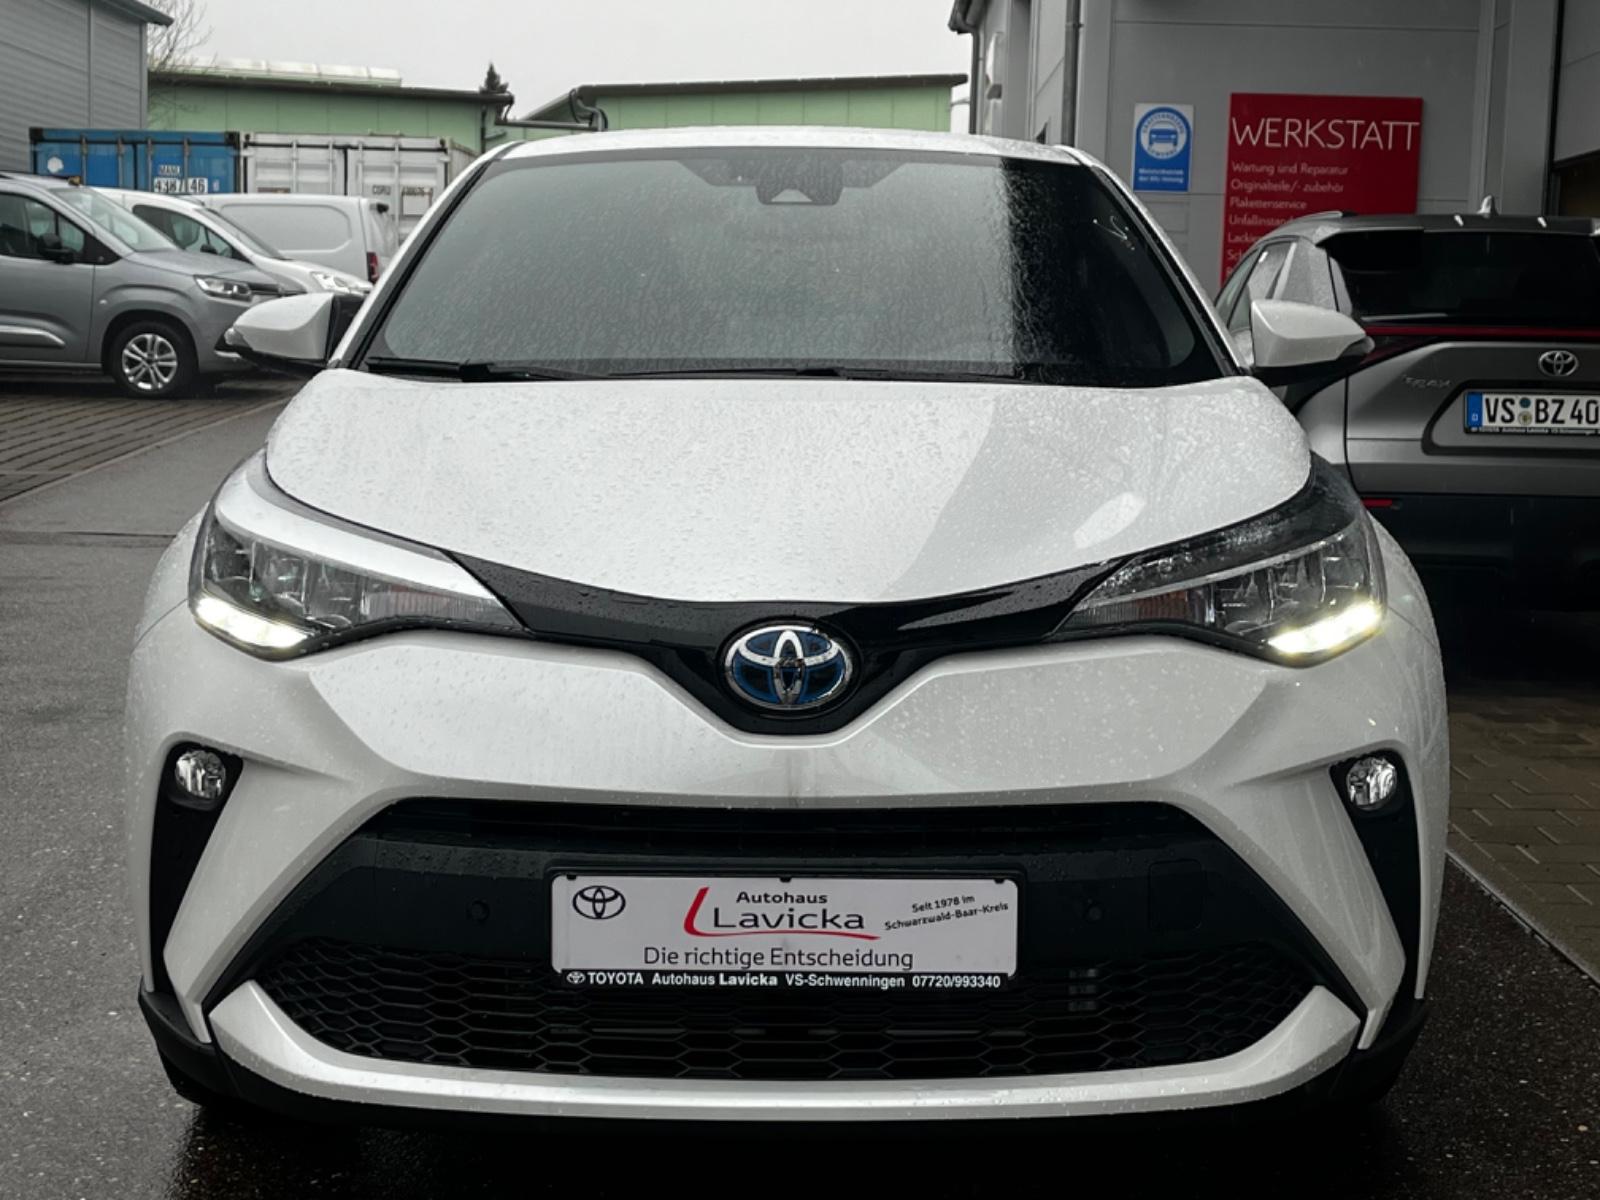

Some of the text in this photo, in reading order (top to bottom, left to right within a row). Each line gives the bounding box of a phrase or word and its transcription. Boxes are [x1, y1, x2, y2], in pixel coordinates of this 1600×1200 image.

[1232, 117, 1420, 150] WERKSTATT
[1231, 162, 1349, 177] Wartung und Reparatur
[1229, 196, 1307, 209] Plakettenservice
[1485, 398, 1515, 423] VS
[1535, 398, 1565, 424] BZ
[736, 892, 828, 904] Autohaus
[912, 894, 975, 913] Seit 1978 im
[713, 907, 865, 930] Lavicka
[884, 902, 1009, 931] Schwarzwald-Baar-Kreis
[644, 947, 914, 972] Die richtige Entscheidung
[587, 972, 1001, 990] TOYOTA Autohaus Lavicka VS-Schwenningen 07720/993340
